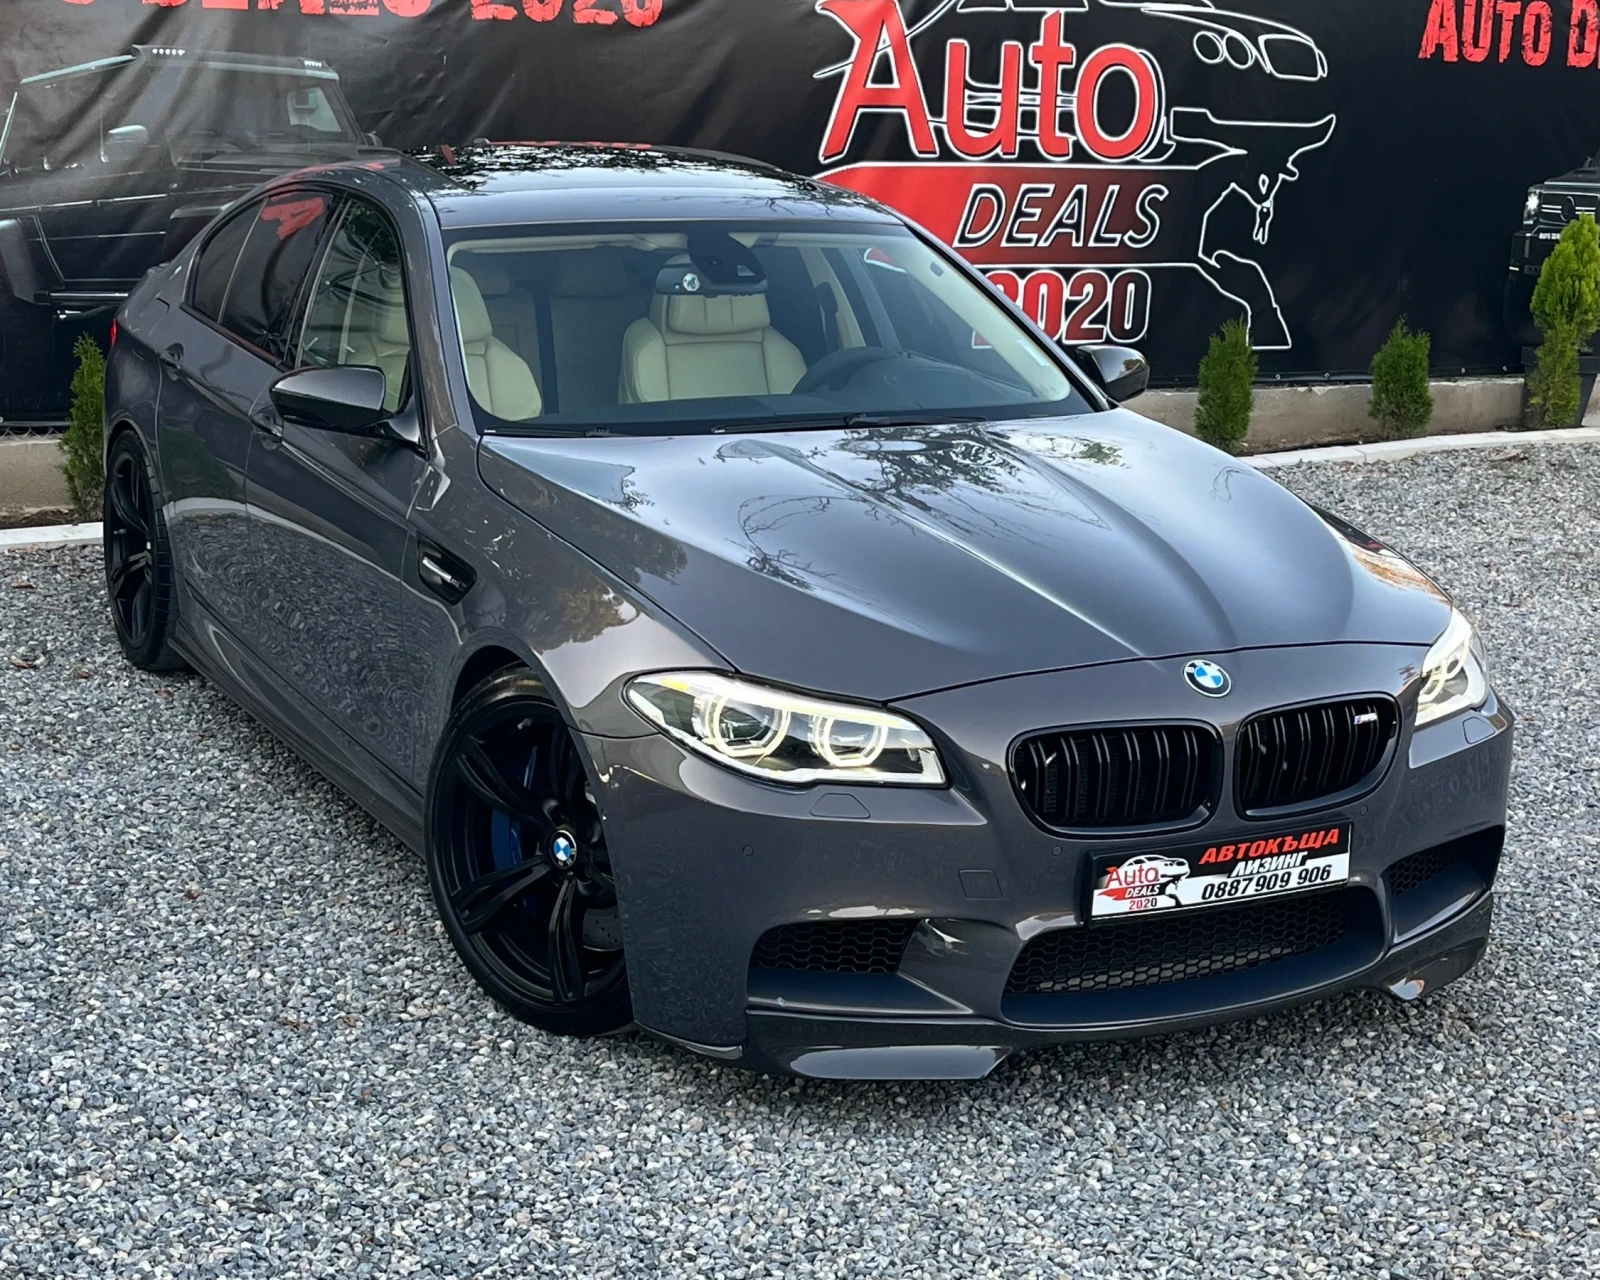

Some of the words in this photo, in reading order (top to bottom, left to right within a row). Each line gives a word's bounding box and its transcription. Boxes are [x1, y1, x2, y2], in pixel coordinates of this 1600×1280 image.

[1566, 0, 1600, 69] D
[815, 0, 1164, 162] Auto
[952, 183, 1169, 249] DEALS
[1198, 828, 1339, 865] АВТОКЪЩА
[1105, 865, 1159, 889] Auto
[1230, 851, 1308, 878] ЛИЗИНГ
[1297, 864, 1333, 885] 906
[1125, 885, 1160, 899] DEALS
[1128, 897, 1158, 911] 2020
